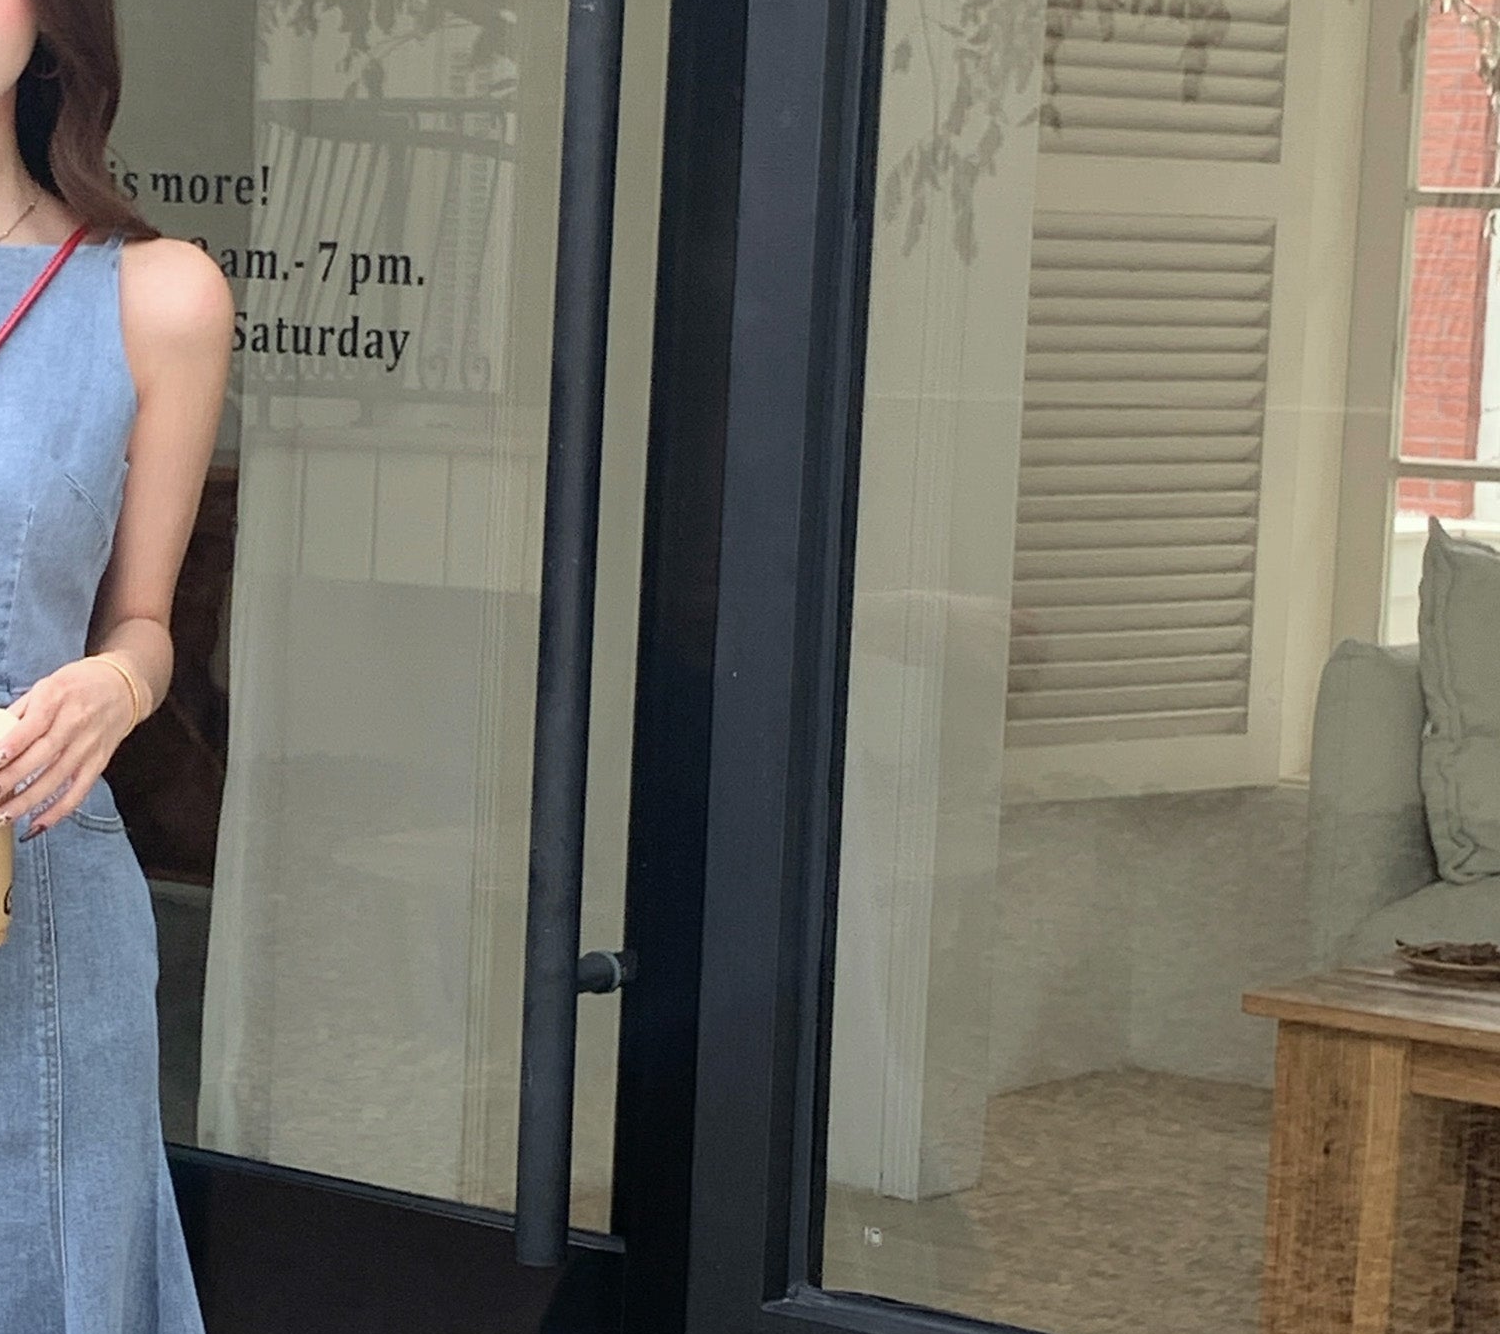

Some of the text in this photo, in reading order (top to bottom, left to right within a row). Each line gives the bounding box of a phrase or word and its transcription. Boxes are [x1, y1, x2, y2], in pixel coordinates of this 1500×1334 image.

[150, 166, 269, 206] more!
[319, 241, 338, 282] 7
[348, 251, 424, 295] pm.
[232, 311, 410, 372] Saturday
